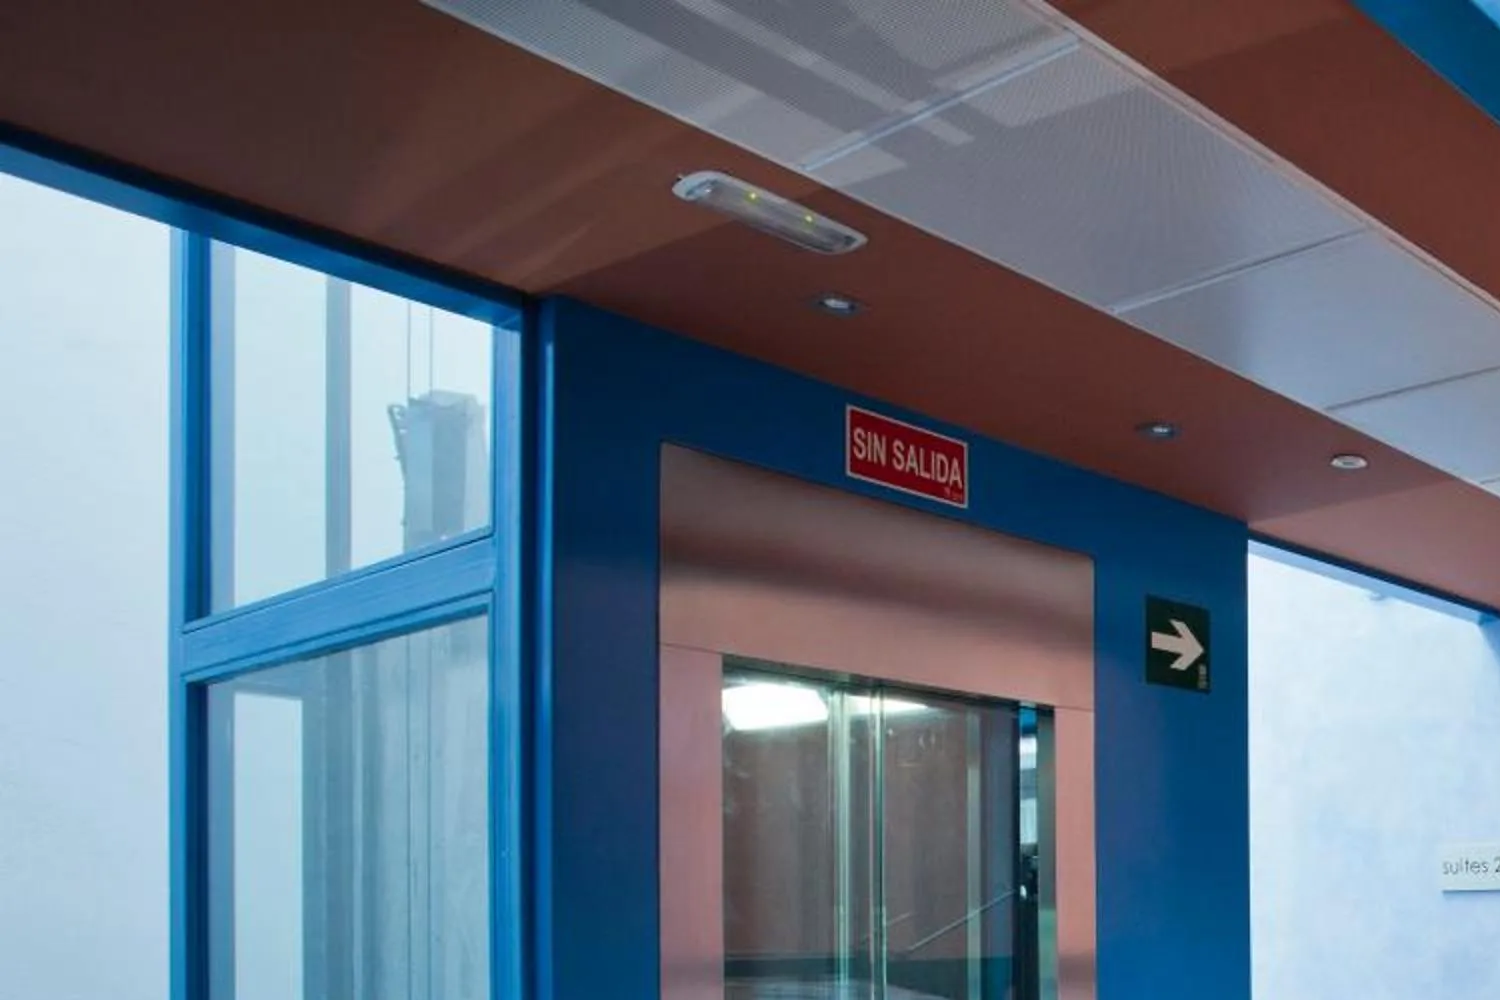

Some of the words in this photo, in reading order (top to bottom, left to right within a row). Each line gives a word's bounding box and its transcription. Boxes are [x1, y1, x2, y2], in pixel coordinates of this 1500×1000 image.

[853, 427, 887, 467] SIN
[892, 440, 963, 489] SALIDA
[1442, 857, 1489, 875] suites
